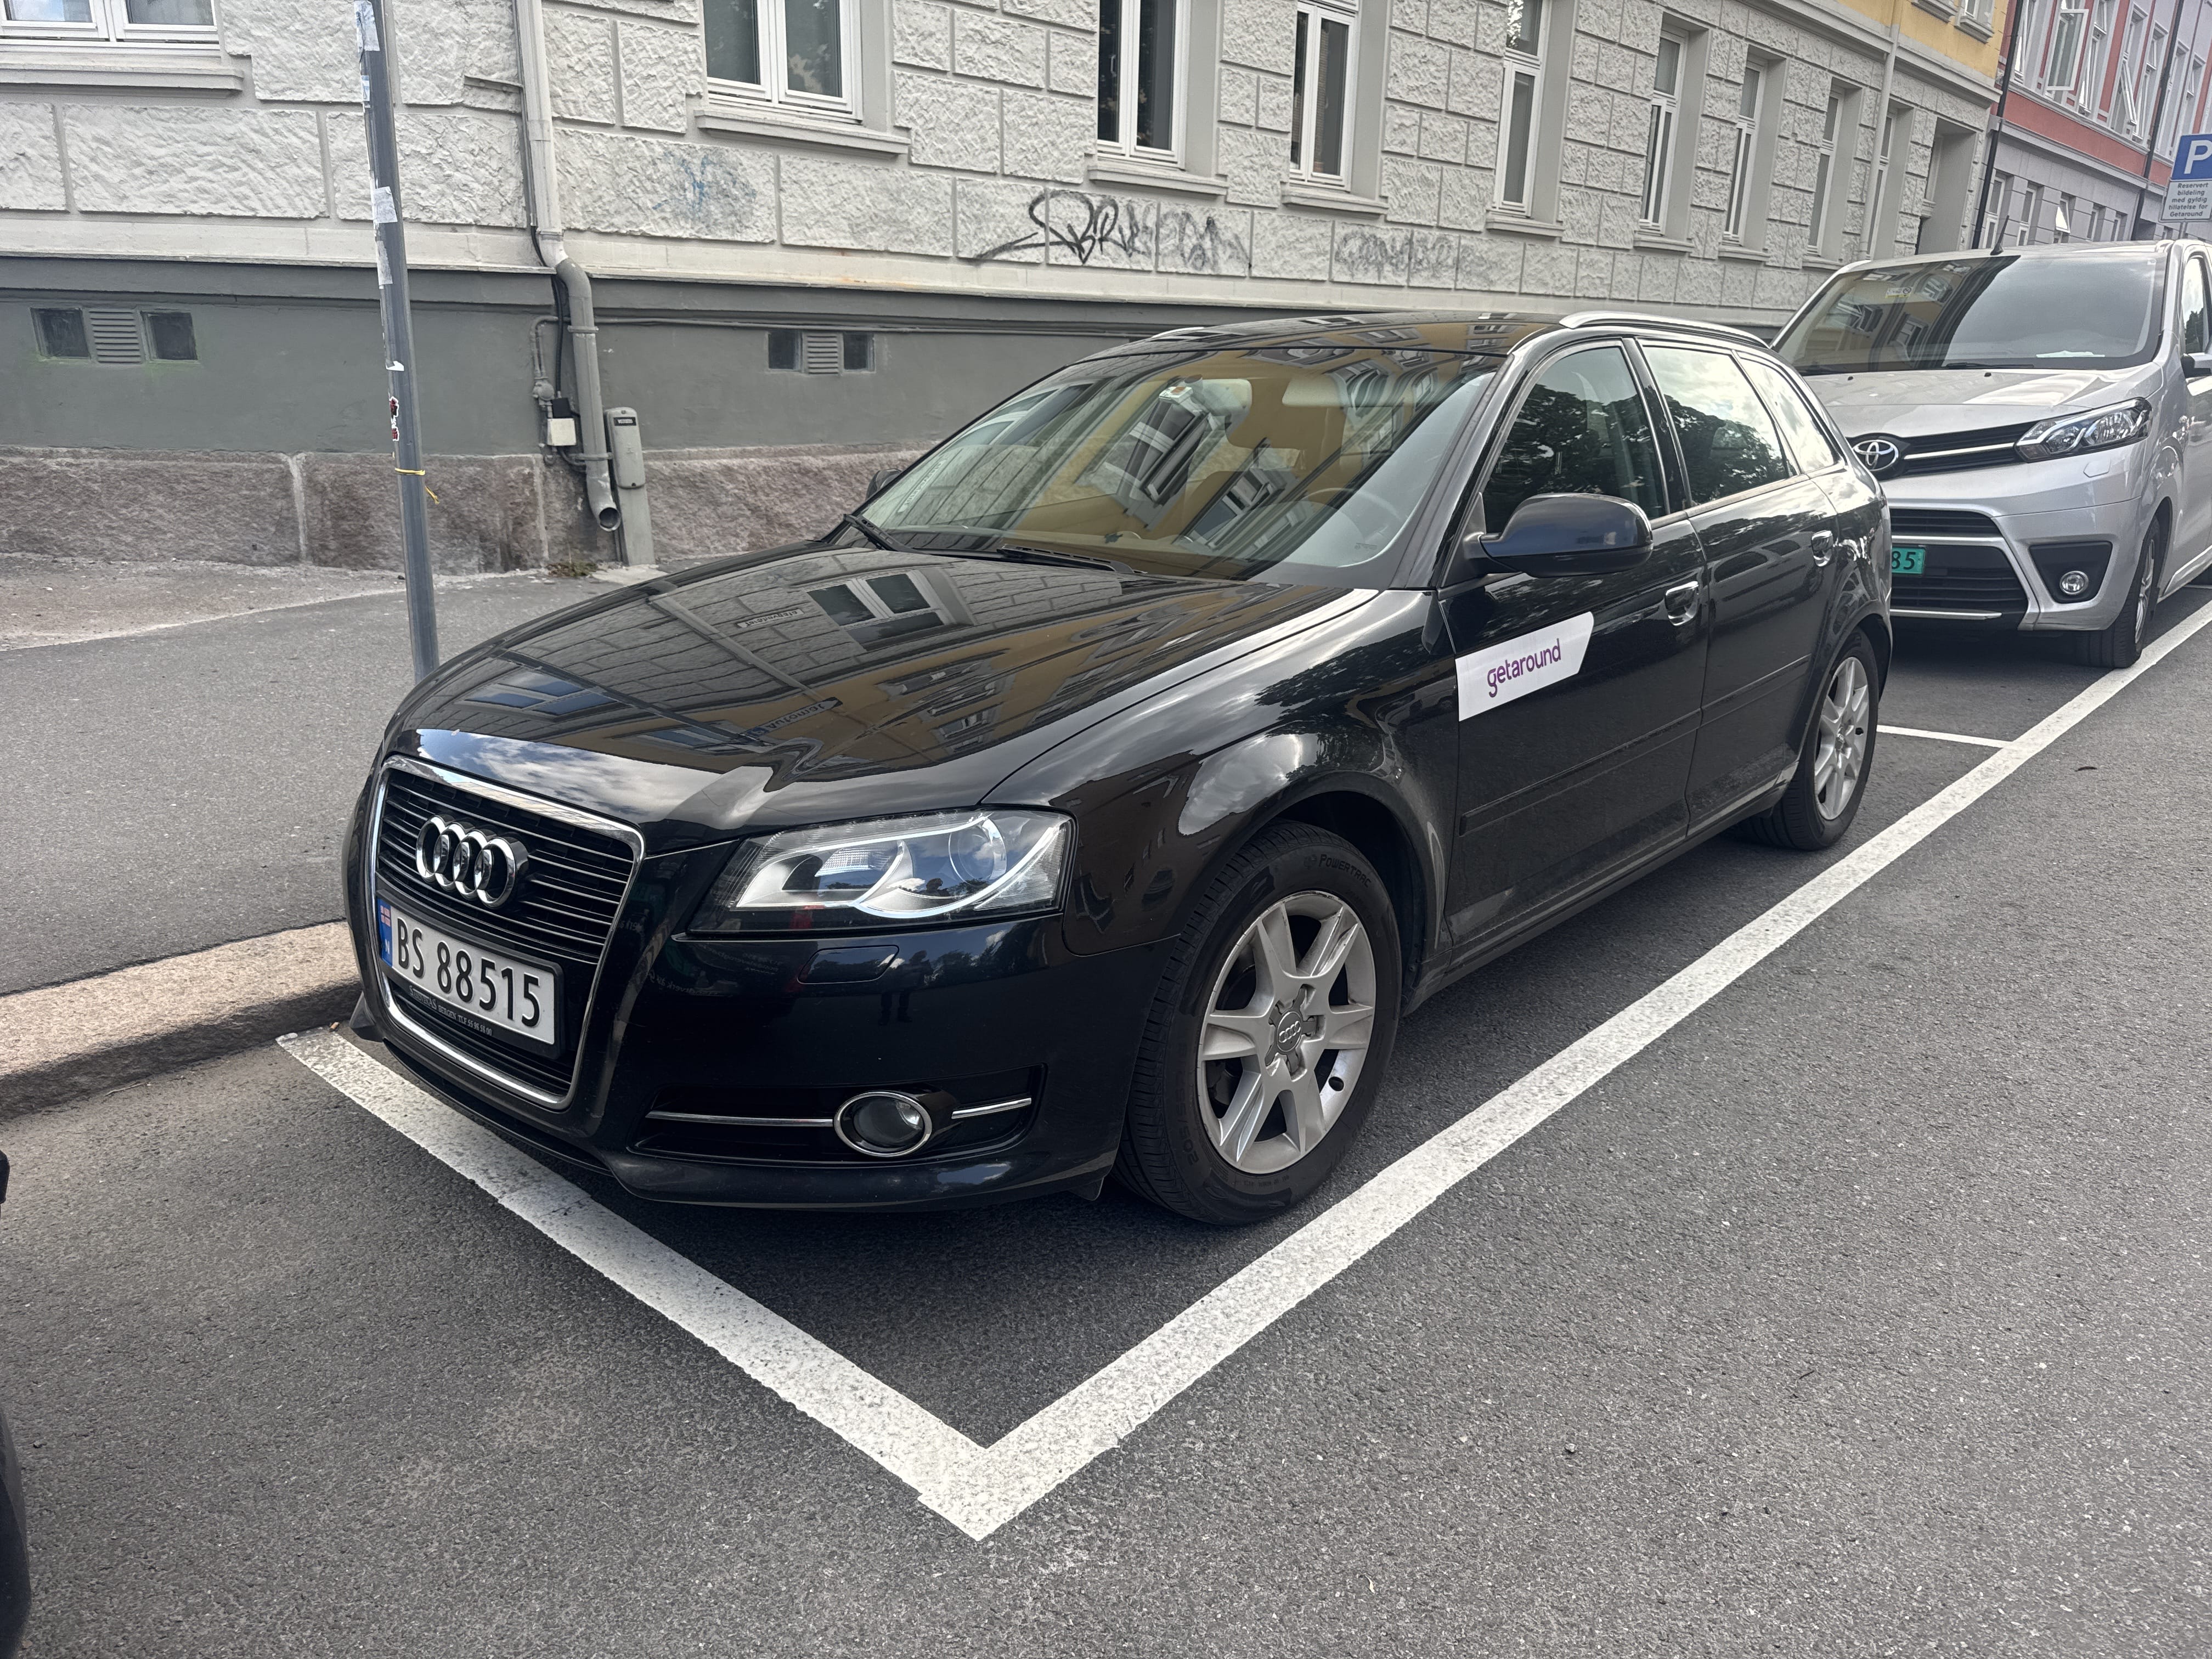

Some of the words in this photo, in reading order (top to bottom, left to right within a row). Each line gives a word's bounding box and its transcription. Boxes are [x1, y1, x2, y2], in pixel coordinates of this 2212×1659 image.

[2184, 140, 2212, 174] P
[1487, 638, 1561, 698] getaround
[1318, 853, 1372, 888] POWERTRAC
[385, 939, 390, 955] N
[397, 917, 425, 979] BS
[437, 940, 540, 1028] 88515
[438, 1005, 457, 1020] BERGEN
